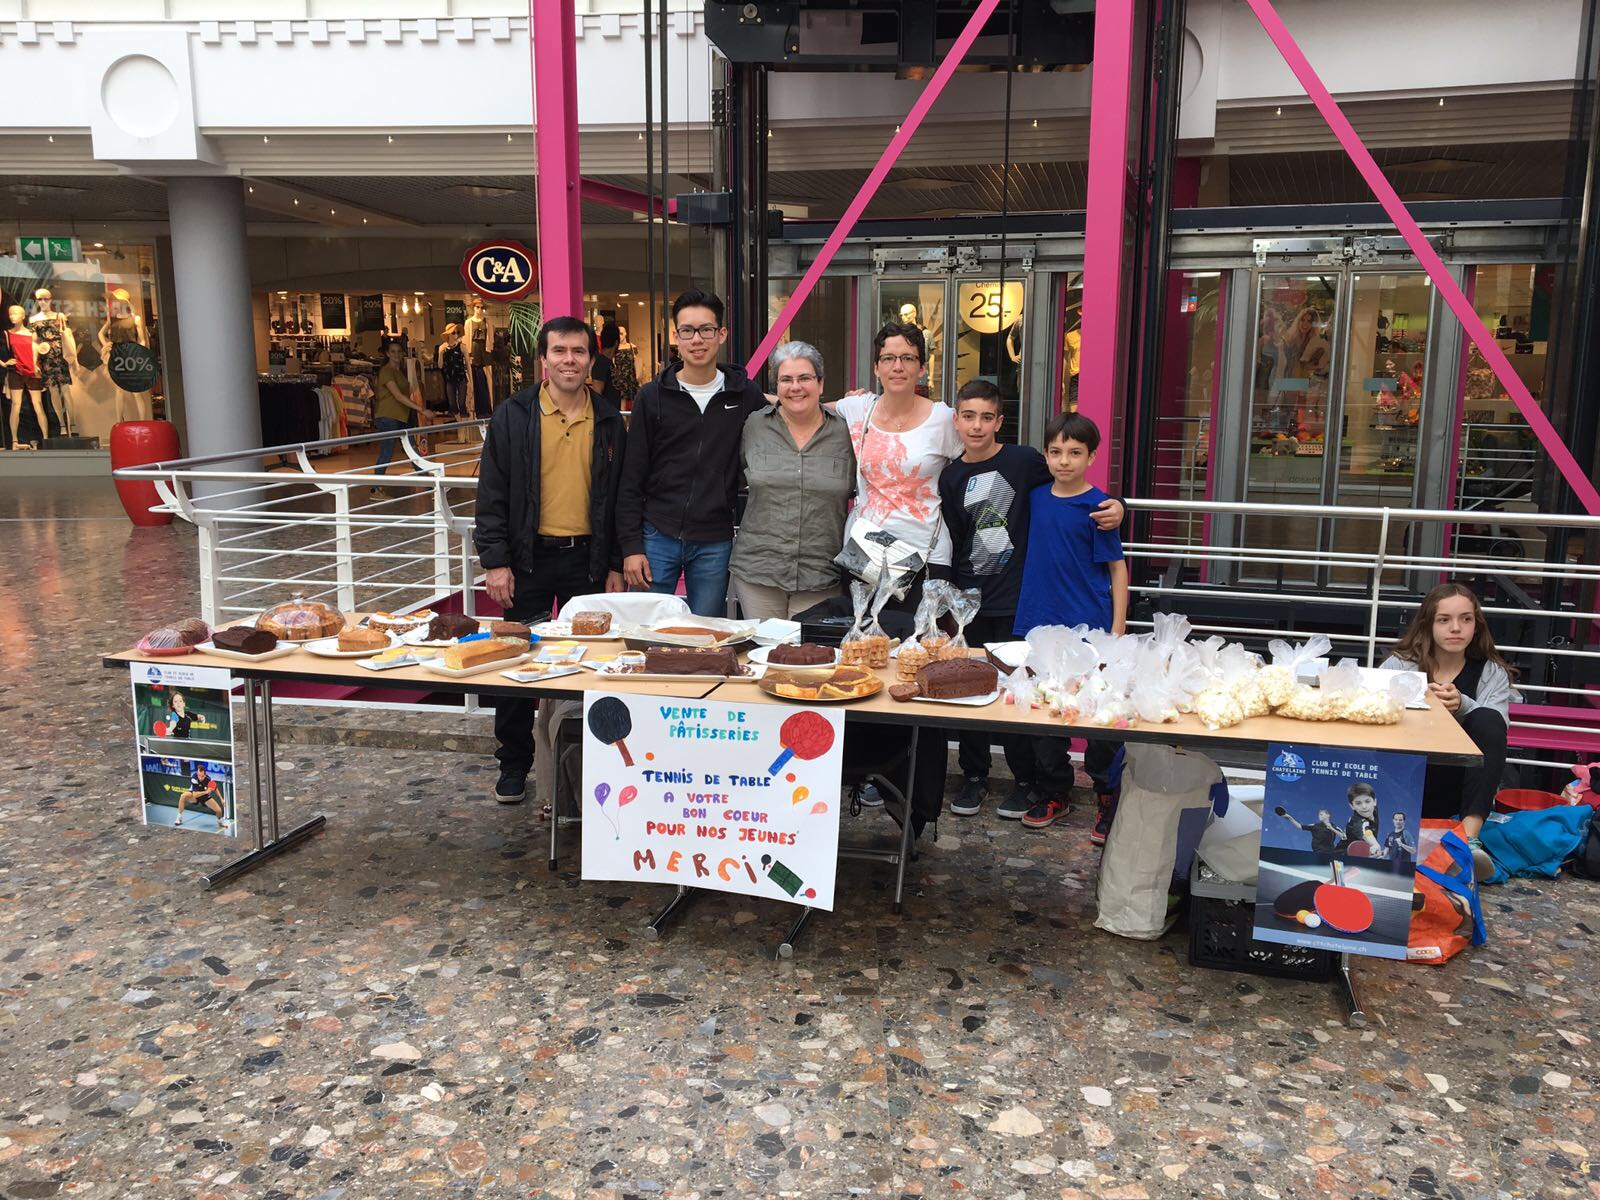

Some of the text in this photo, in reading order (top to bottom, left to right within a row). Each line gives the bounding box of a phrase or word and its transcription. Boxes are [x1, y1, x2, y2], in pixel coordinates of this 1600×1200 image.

[476, 256, 525, 283] C&A
[323, 296, 343, 305] 20%
[364, 300, 381, 309] 20%
[446, 306, 462, 314] 20%
[114, 356, 153, 372] 20%
[660, 706, 746, 722] VENTE DE
[1311, 767, 1338, 776] TENNIS
[1355, 771, 1378, 779] TABLE
[1344, 763, 1366, 771] ECOLE
[704, 774, 720, 785] DE
[728, 775, 771, 787] TABLE
[663, 791, 729, 804] A VOTRE
[683, 807, 768, 823] BON COEUR
[646, 821, 796, 845] POUR NOS JEUNES
